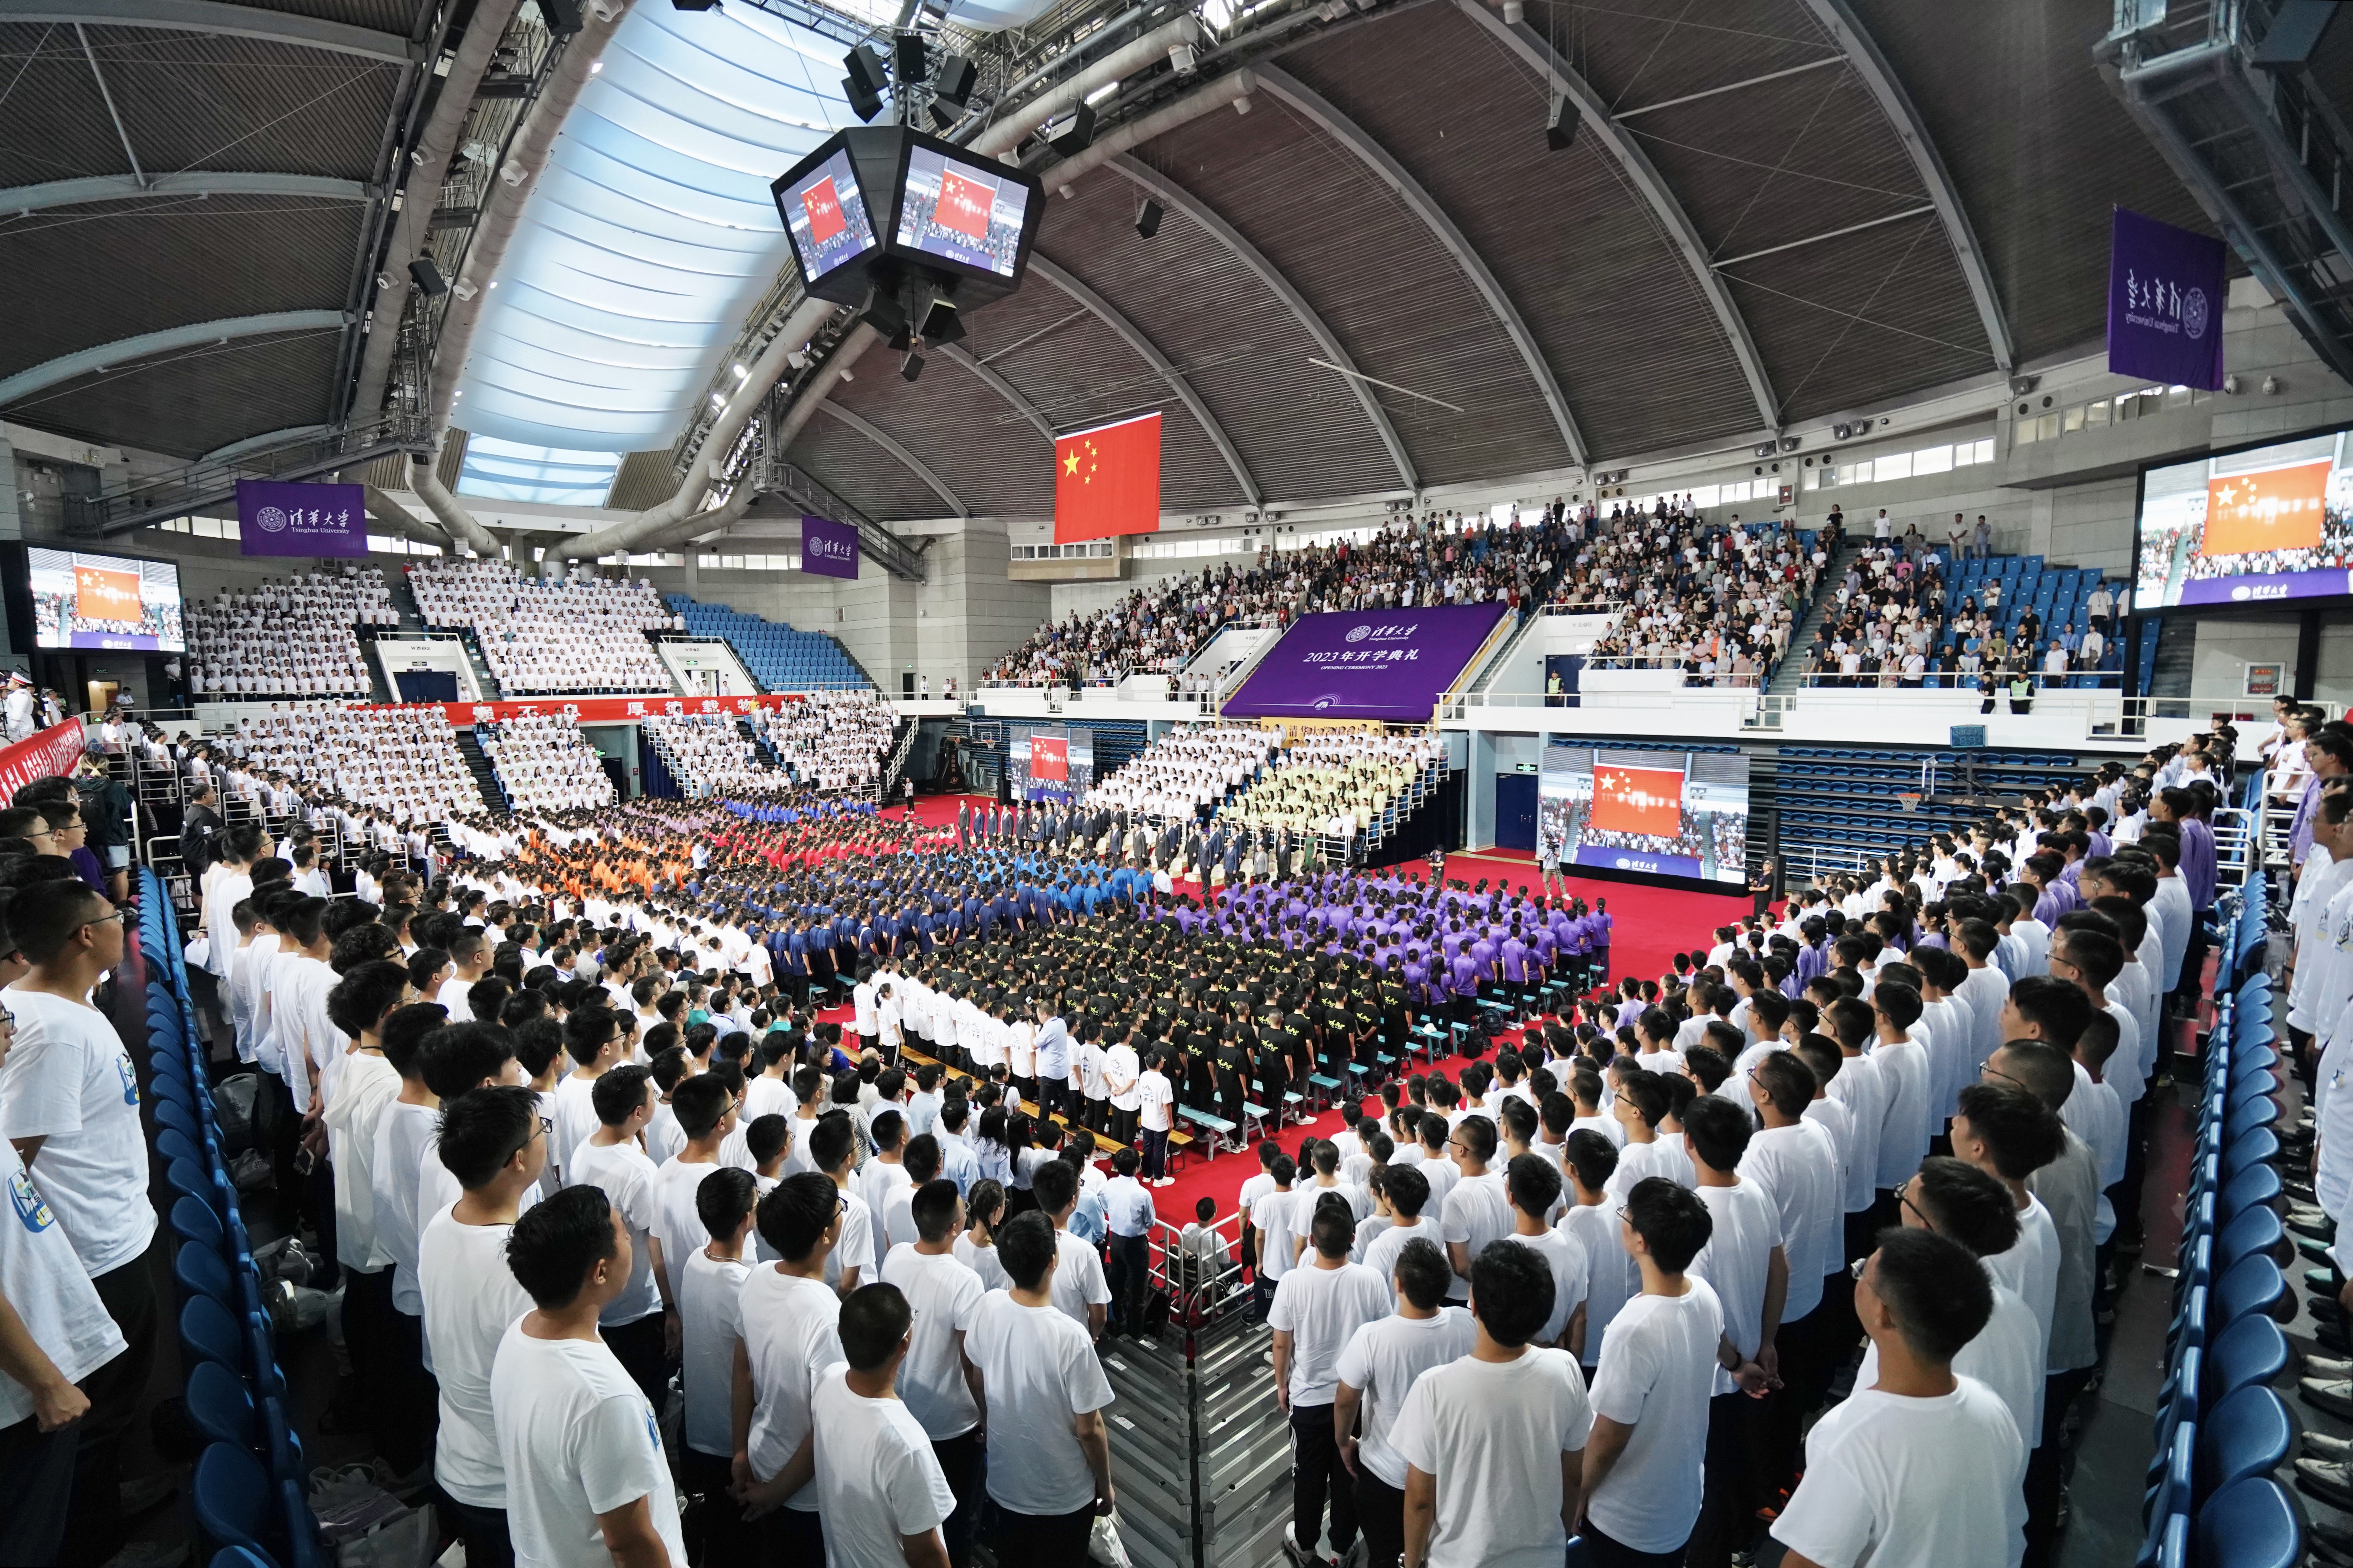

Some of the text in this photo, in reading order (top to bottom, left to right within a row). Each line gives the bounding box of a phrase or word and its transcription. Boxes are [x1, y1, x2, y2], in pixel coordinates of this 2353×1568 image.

[1303, 649, 1419, 662] 2023年开学典礼
